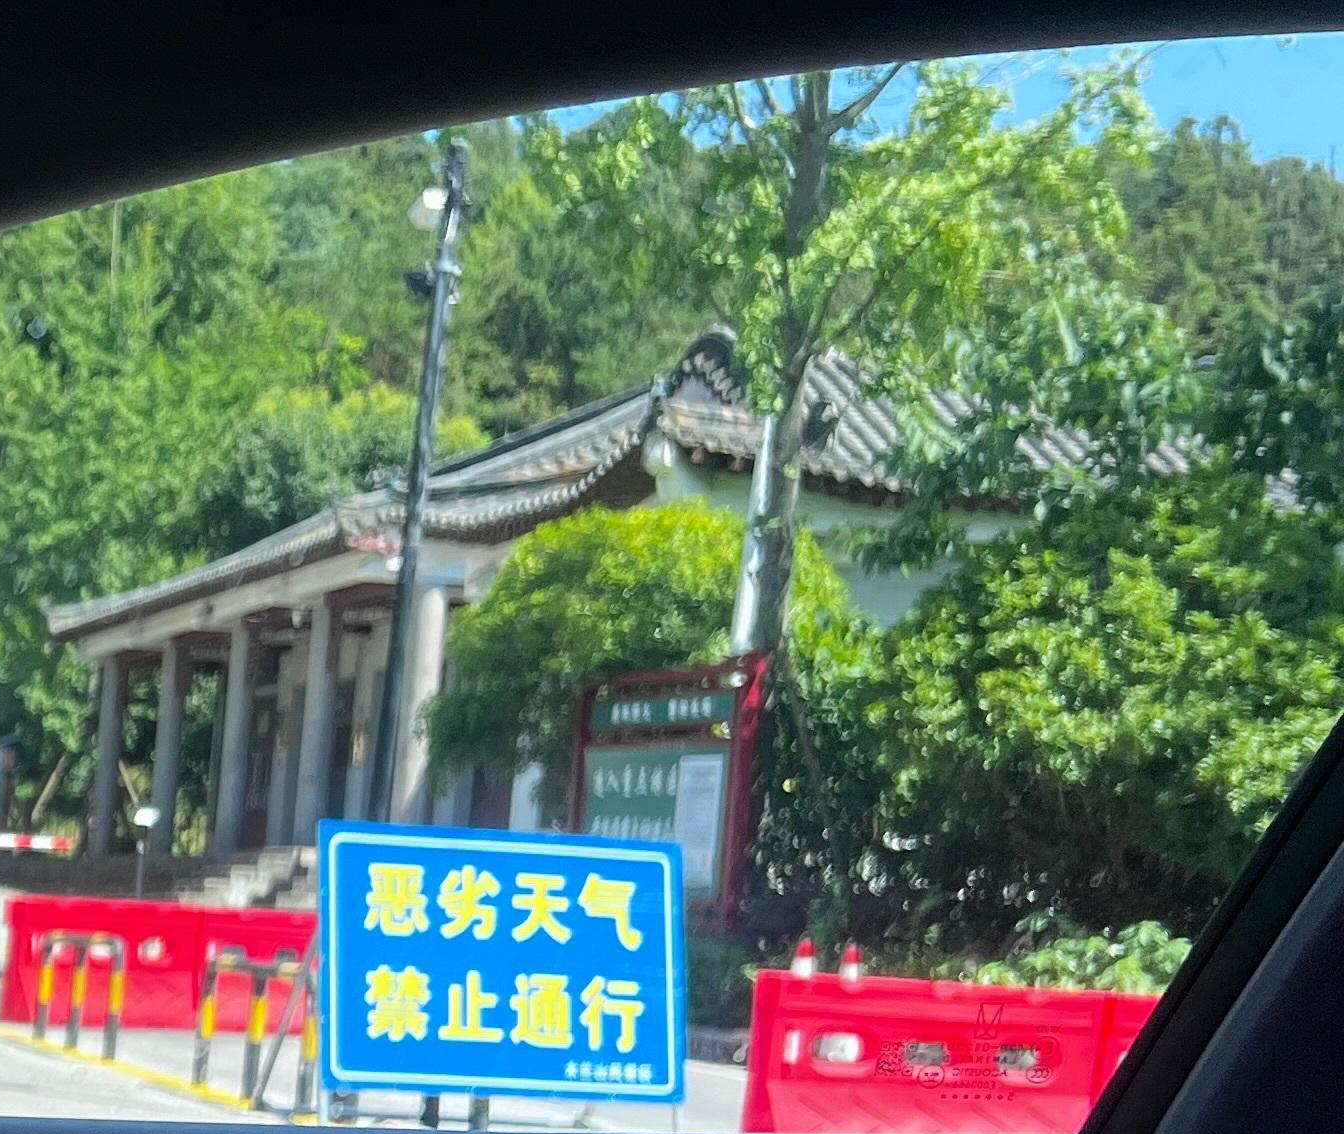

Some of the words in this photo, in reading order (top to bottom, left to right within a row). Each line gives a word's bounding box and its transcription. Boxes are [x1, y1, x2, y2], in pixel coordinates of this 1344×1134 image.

[364, 862, 643, 952] 恶劣天气
[364, 963, 645, 1054] 禁止通行
